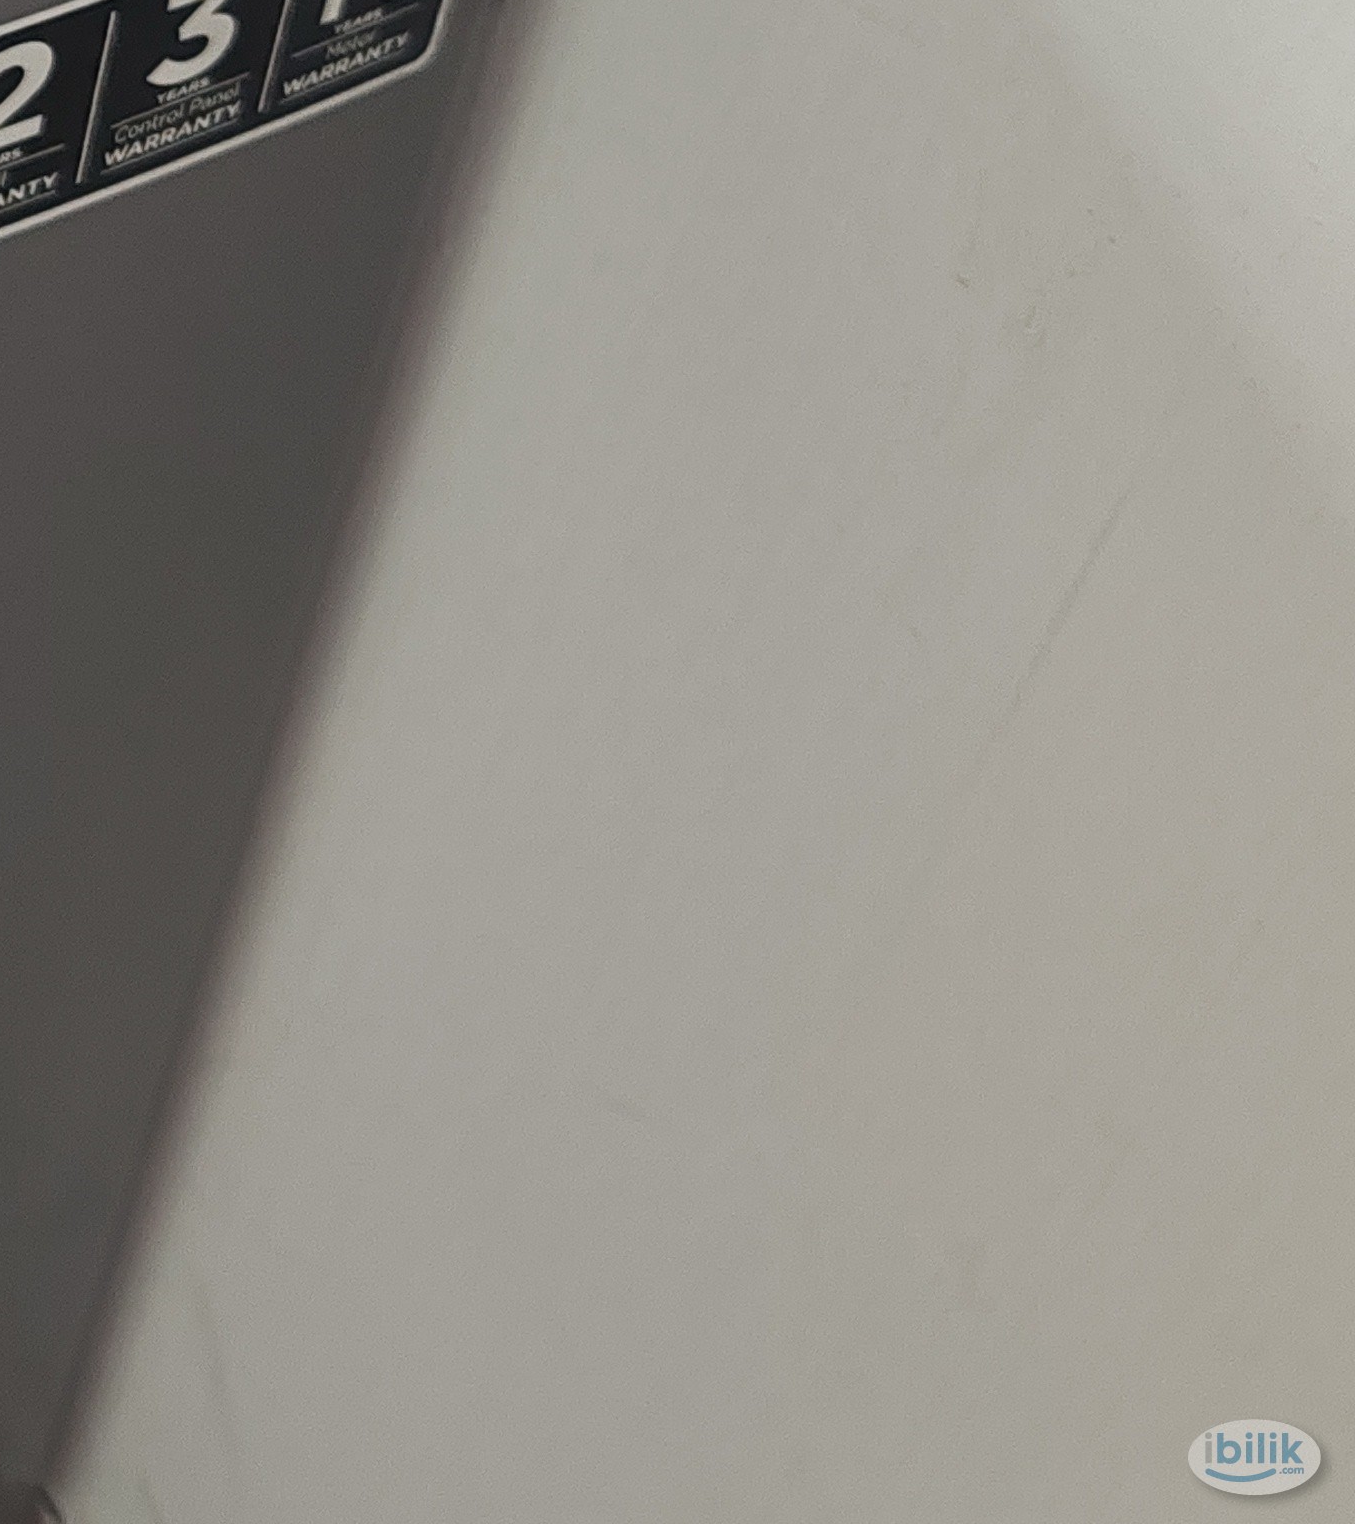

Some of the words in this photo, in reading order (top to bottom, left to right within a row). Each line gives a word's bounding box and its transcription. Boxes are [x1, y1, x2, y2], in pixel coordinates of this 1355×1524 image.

[156, 76, 211, 105] YEARS
[282, 29, 410, 97] WARRANTY
[104, 98, 243, 167] WARRANTY
[114, 102, 185, 145] Control
